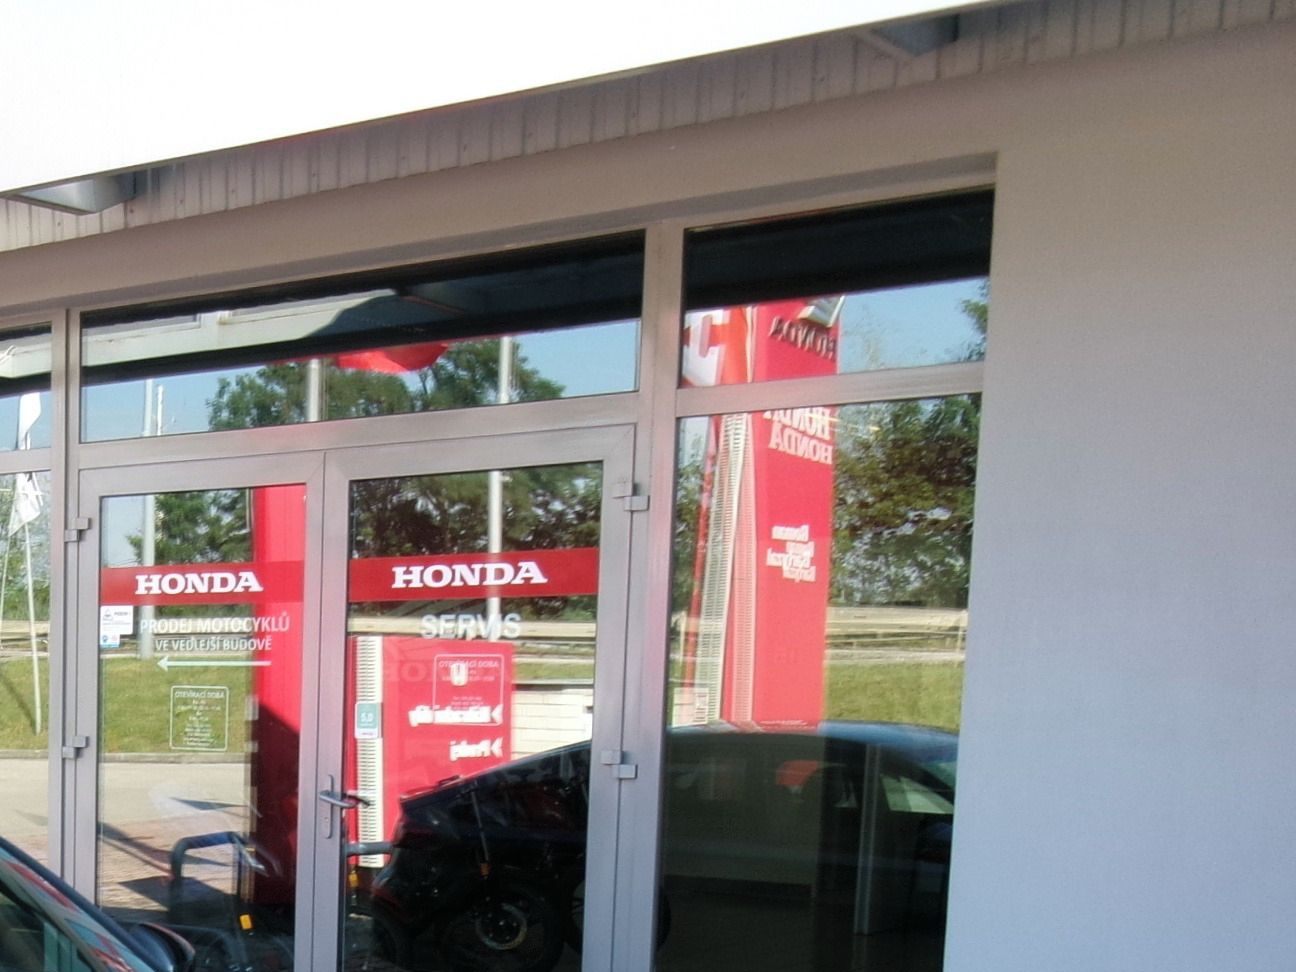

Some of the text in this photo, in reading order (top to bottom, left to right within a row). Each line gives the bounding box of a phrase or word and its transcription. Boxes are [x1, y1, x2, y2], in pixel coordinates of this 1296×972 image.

[135, 571, 264, 595] HONDA
[392, 561, 548, 589] HONDA
[140, 617, 194, 634] PRODEJ
[199, 611, 291, 633] MOTOCYKLŮ
[155, 639, 170, 651] VE
[222, 636, 272, 651] BUDOVĚ
